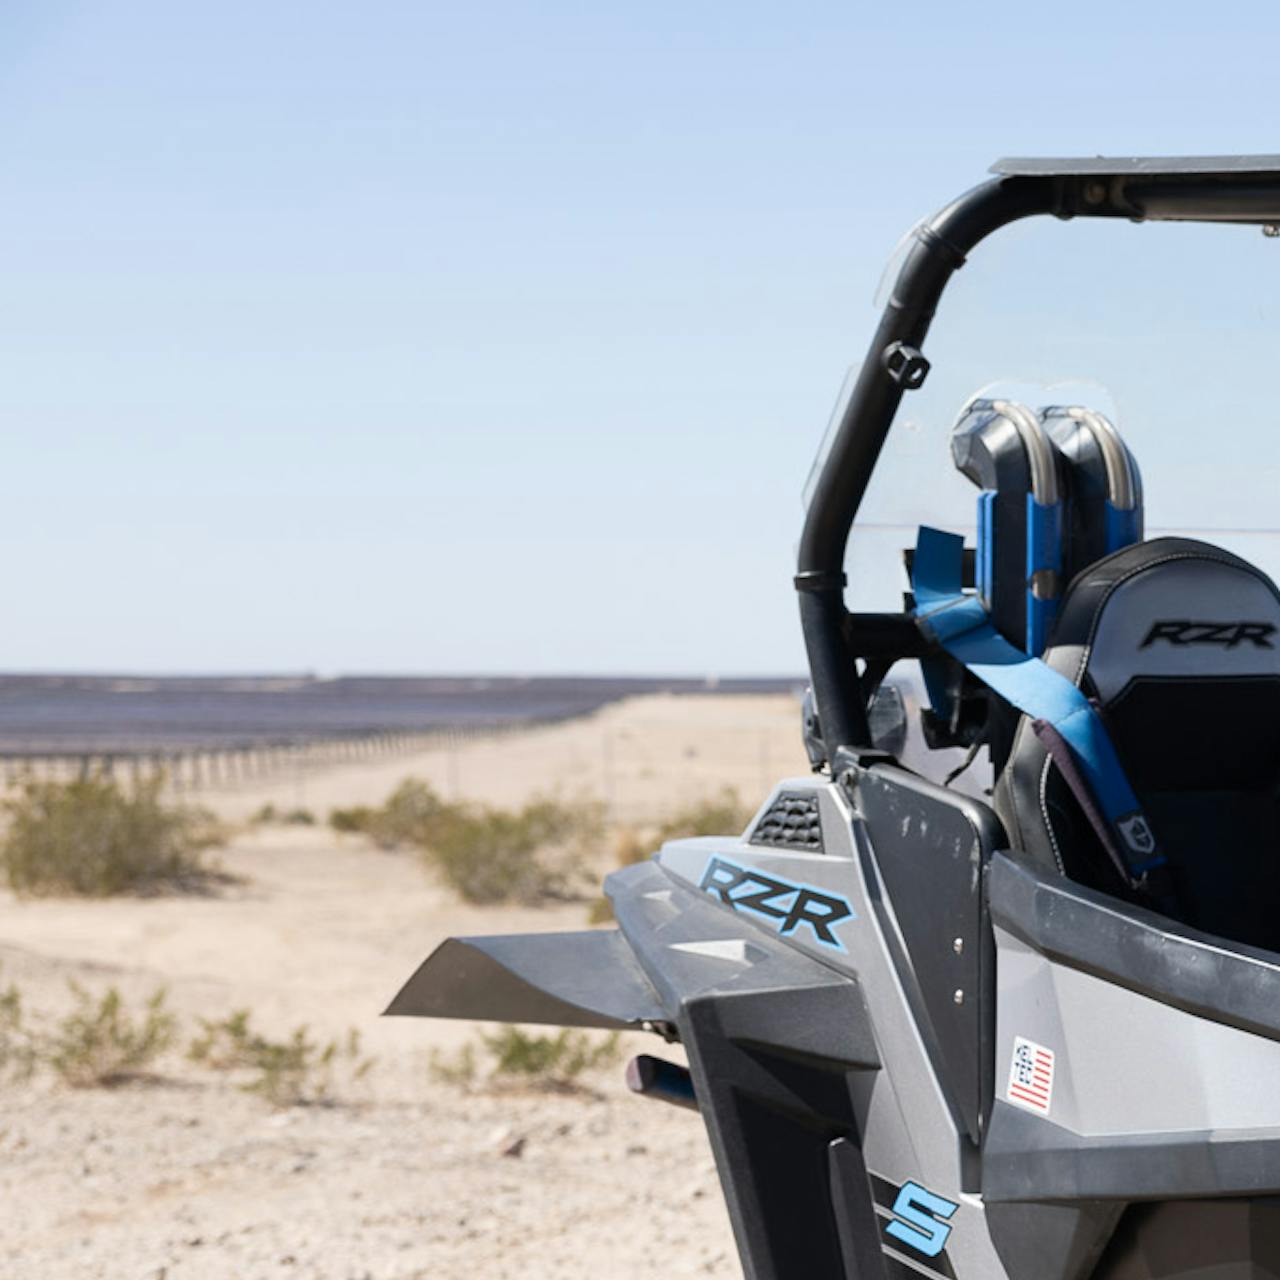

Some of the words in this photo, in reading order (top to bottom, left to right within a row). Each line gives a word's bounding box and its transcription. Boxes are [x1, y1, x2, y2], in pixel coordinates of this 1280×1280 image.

[1137, 619, 1278, 651] RZR
[698, 852, 858, 955] RZR
[884, 1180, 960, 1257] S
